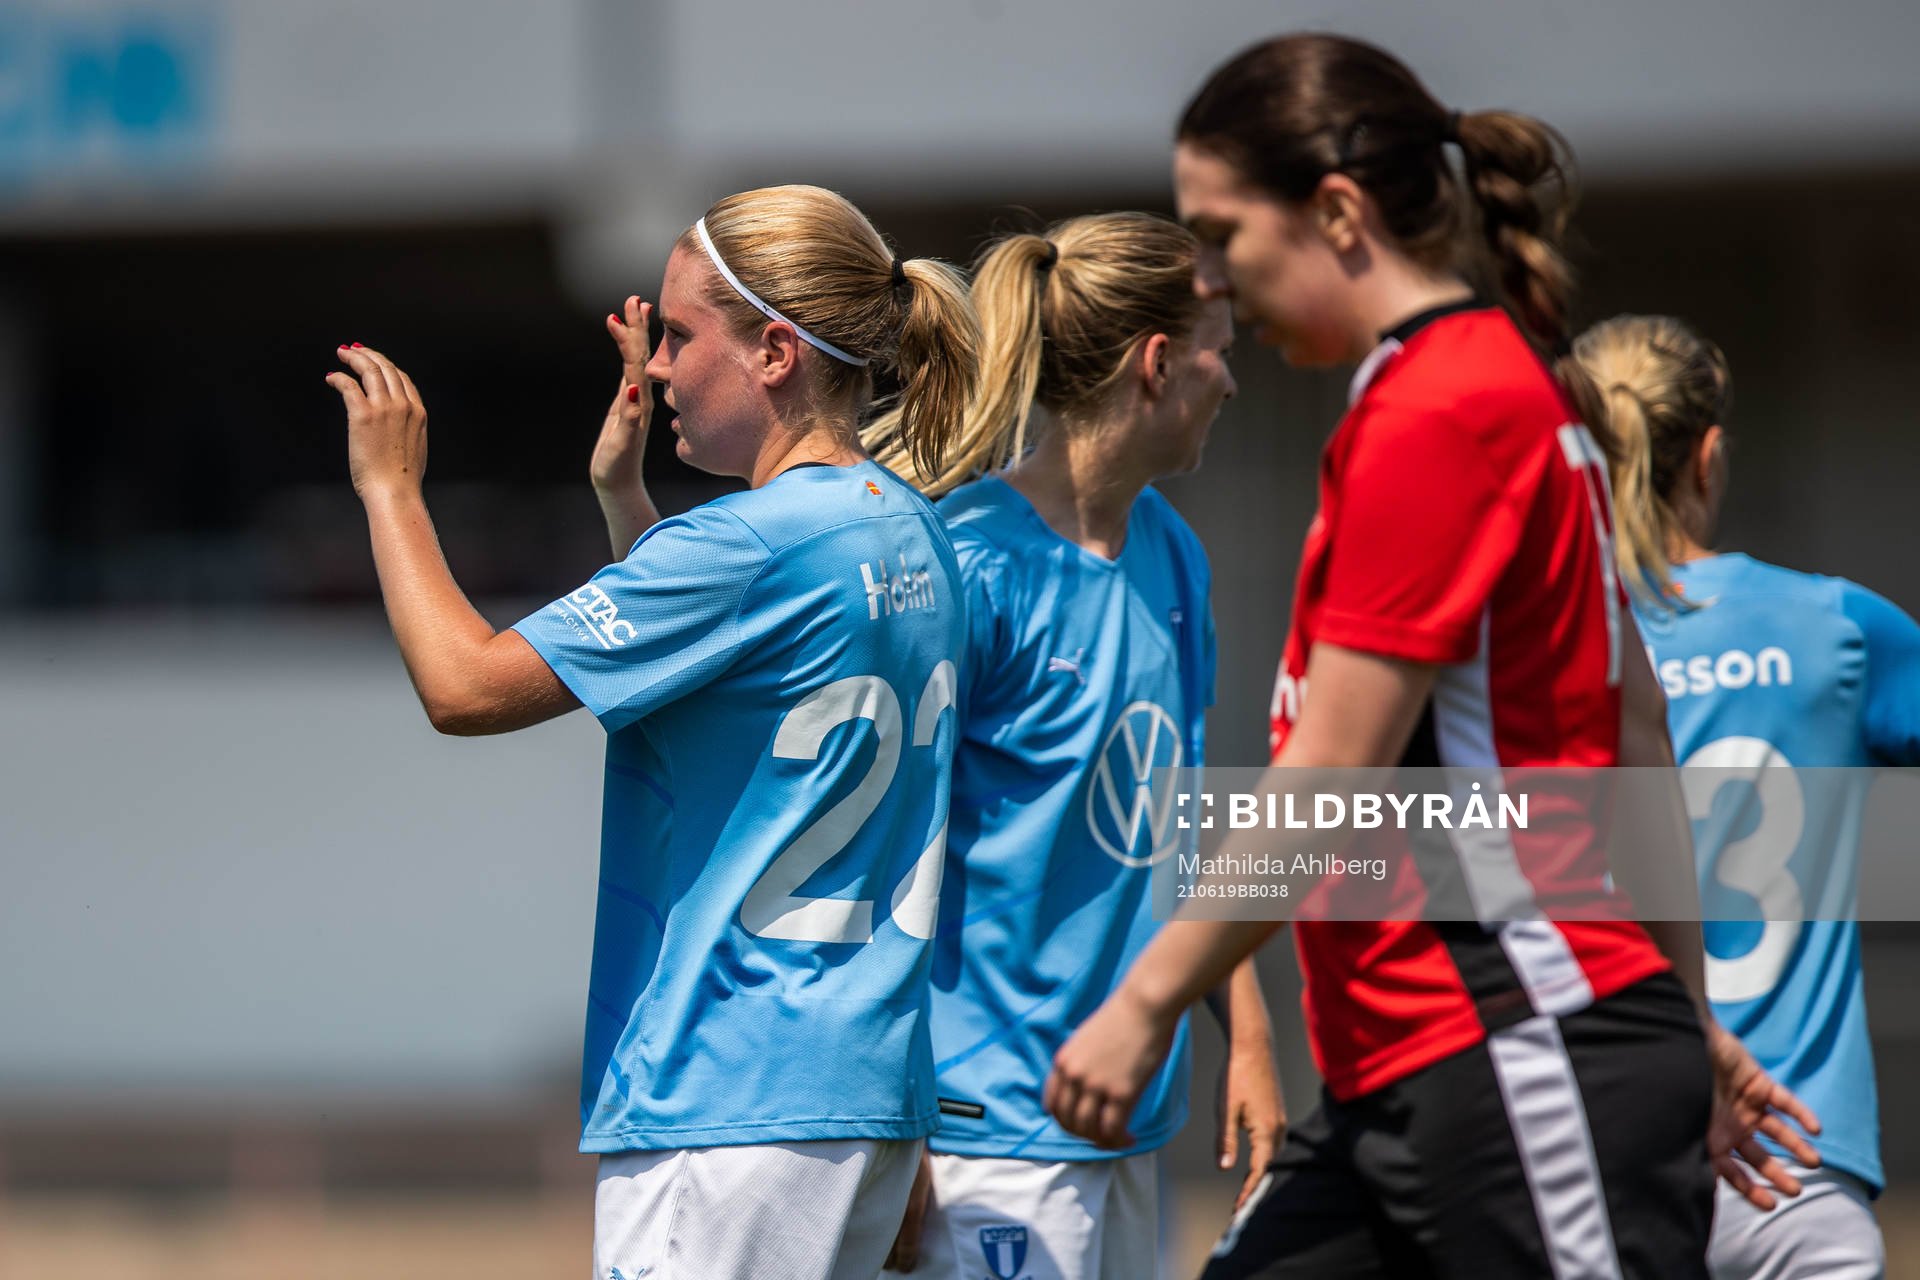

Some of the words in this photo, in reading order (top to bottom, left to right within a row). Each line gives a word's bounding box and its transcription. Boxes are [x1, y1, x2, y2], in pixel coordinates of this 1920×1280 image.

[859, 553, 936, 621] Holm
[1645, 646, 1792, 699] sson
[1681, 736, 1804, 1003] 3
